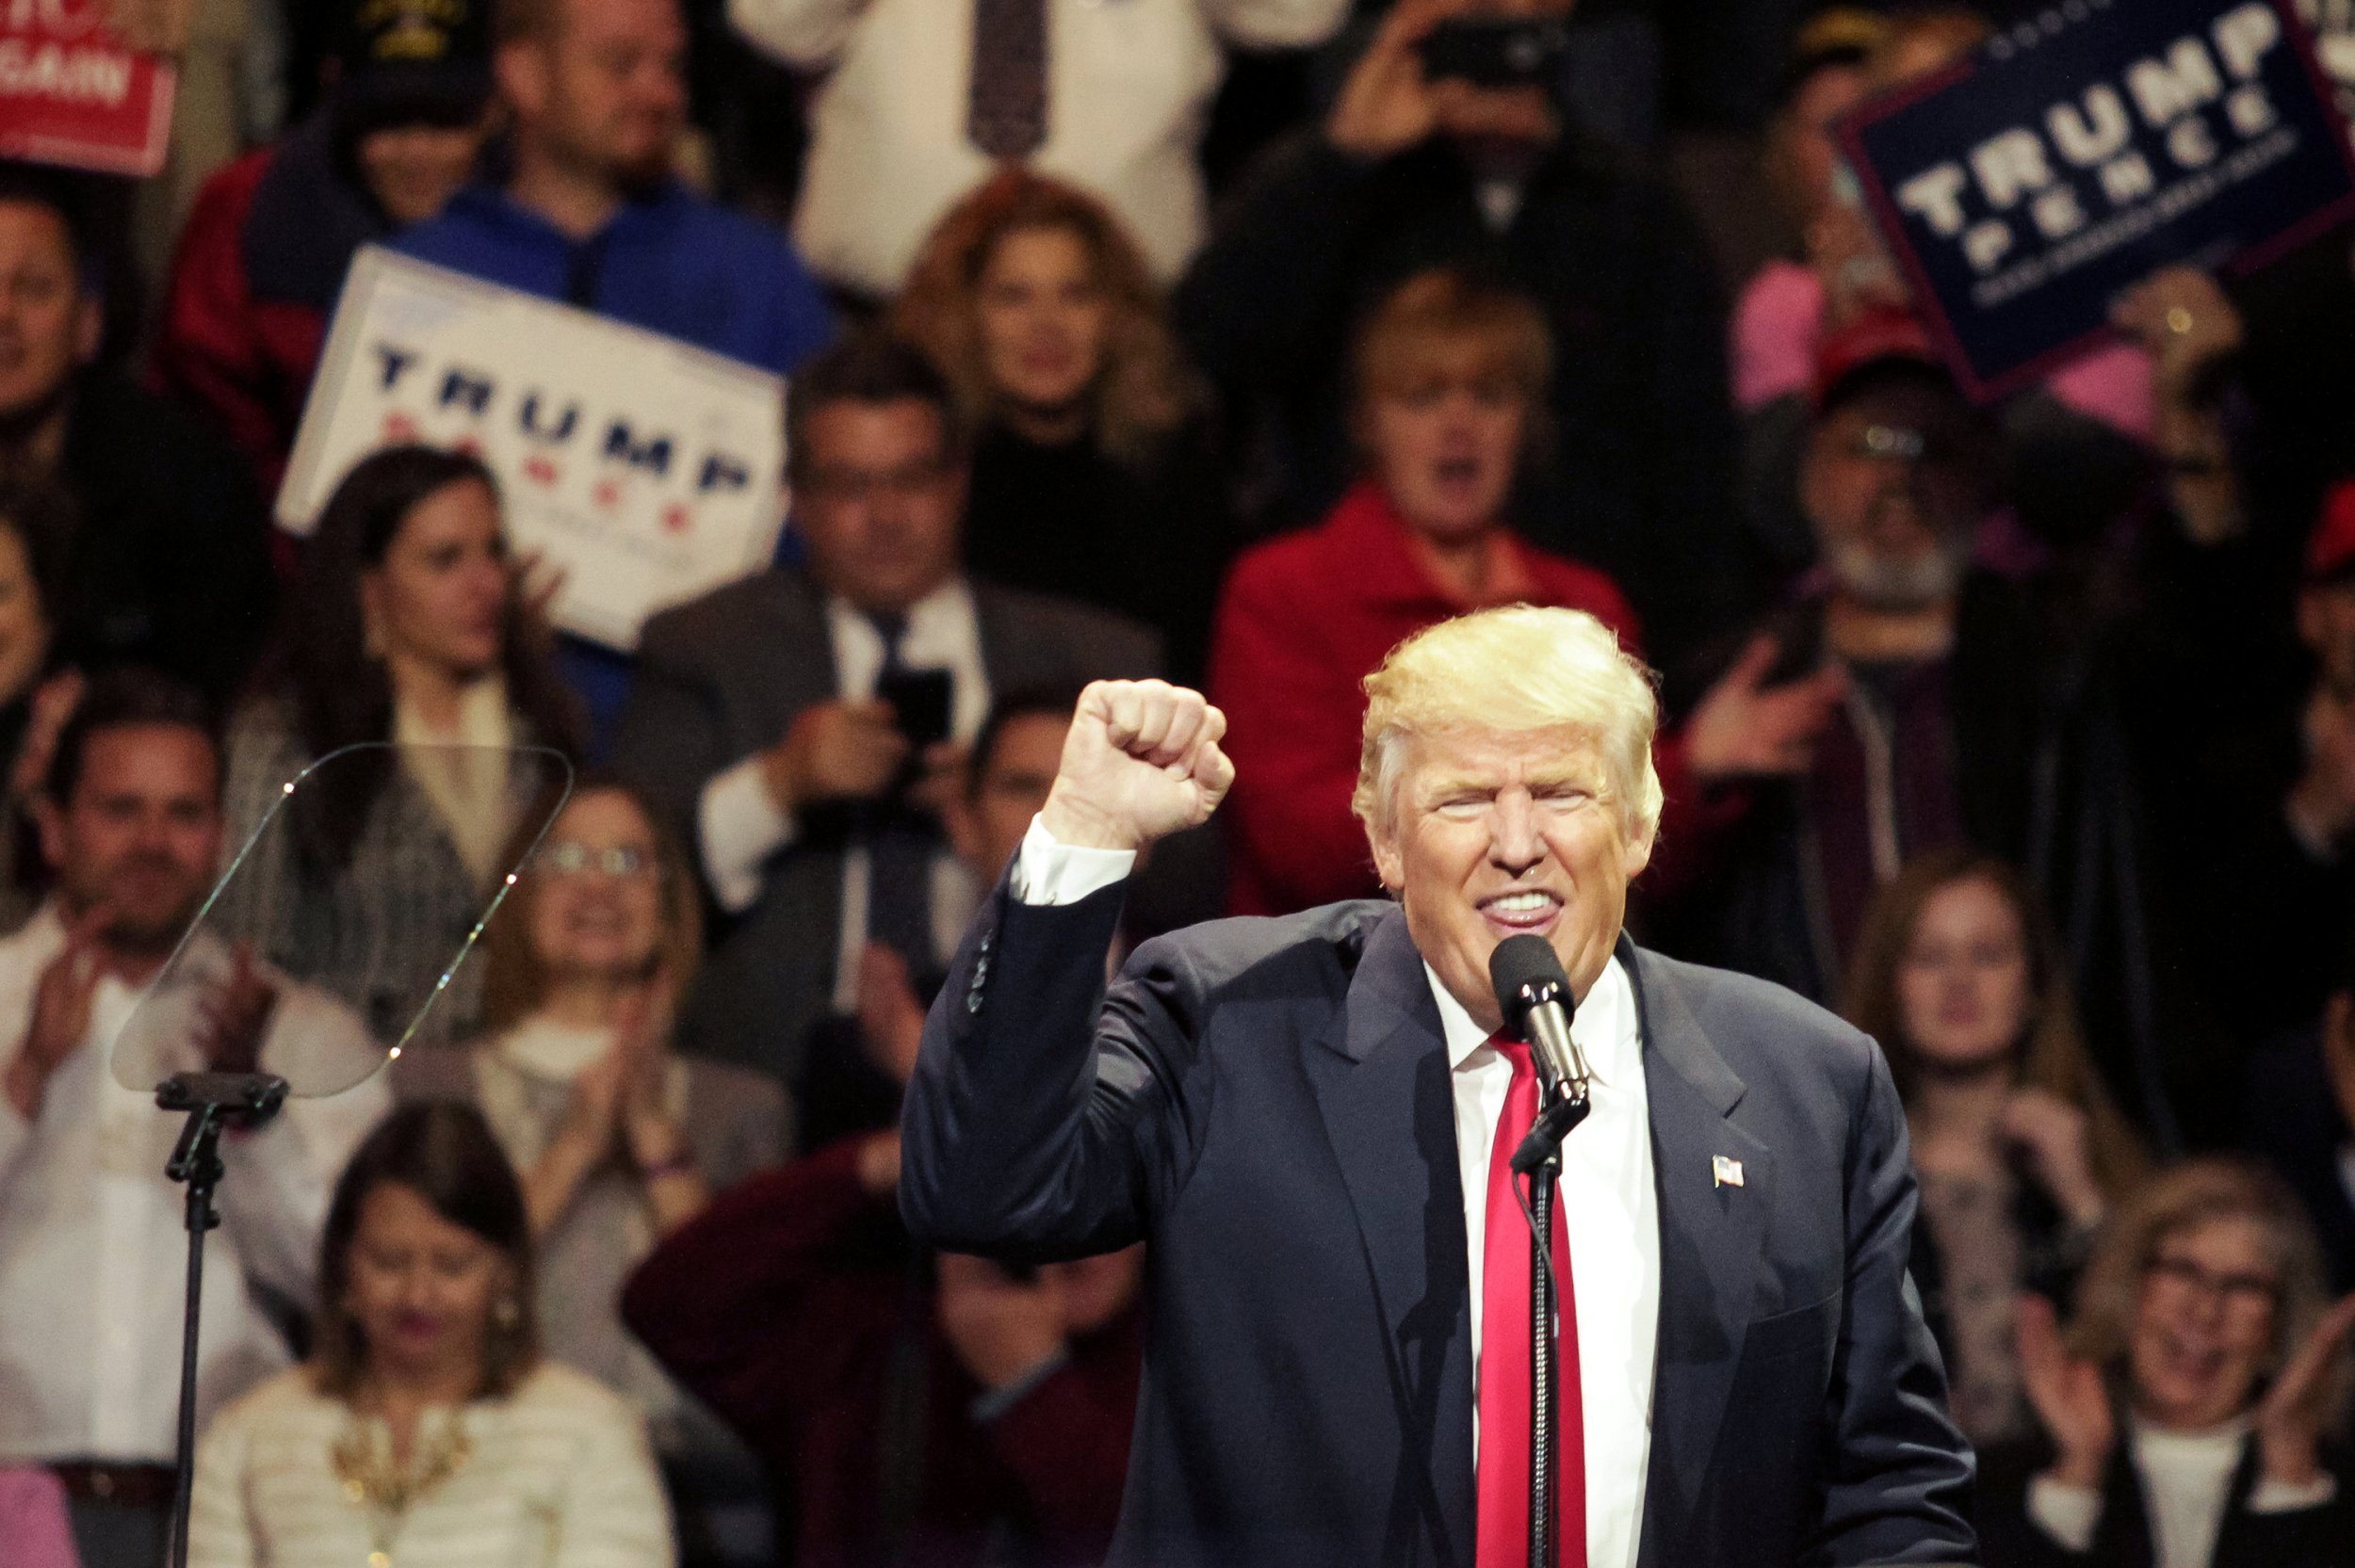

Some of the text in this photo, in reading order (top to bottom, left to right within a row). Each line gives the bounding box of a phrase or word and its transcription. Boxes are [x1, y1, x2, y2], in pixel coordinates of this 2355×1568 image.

[1893, 4, 2281, 237] TRUMP
[1962, 81, 2280, 272] PENCE
[370, 342, 752, 494] TRUMP
